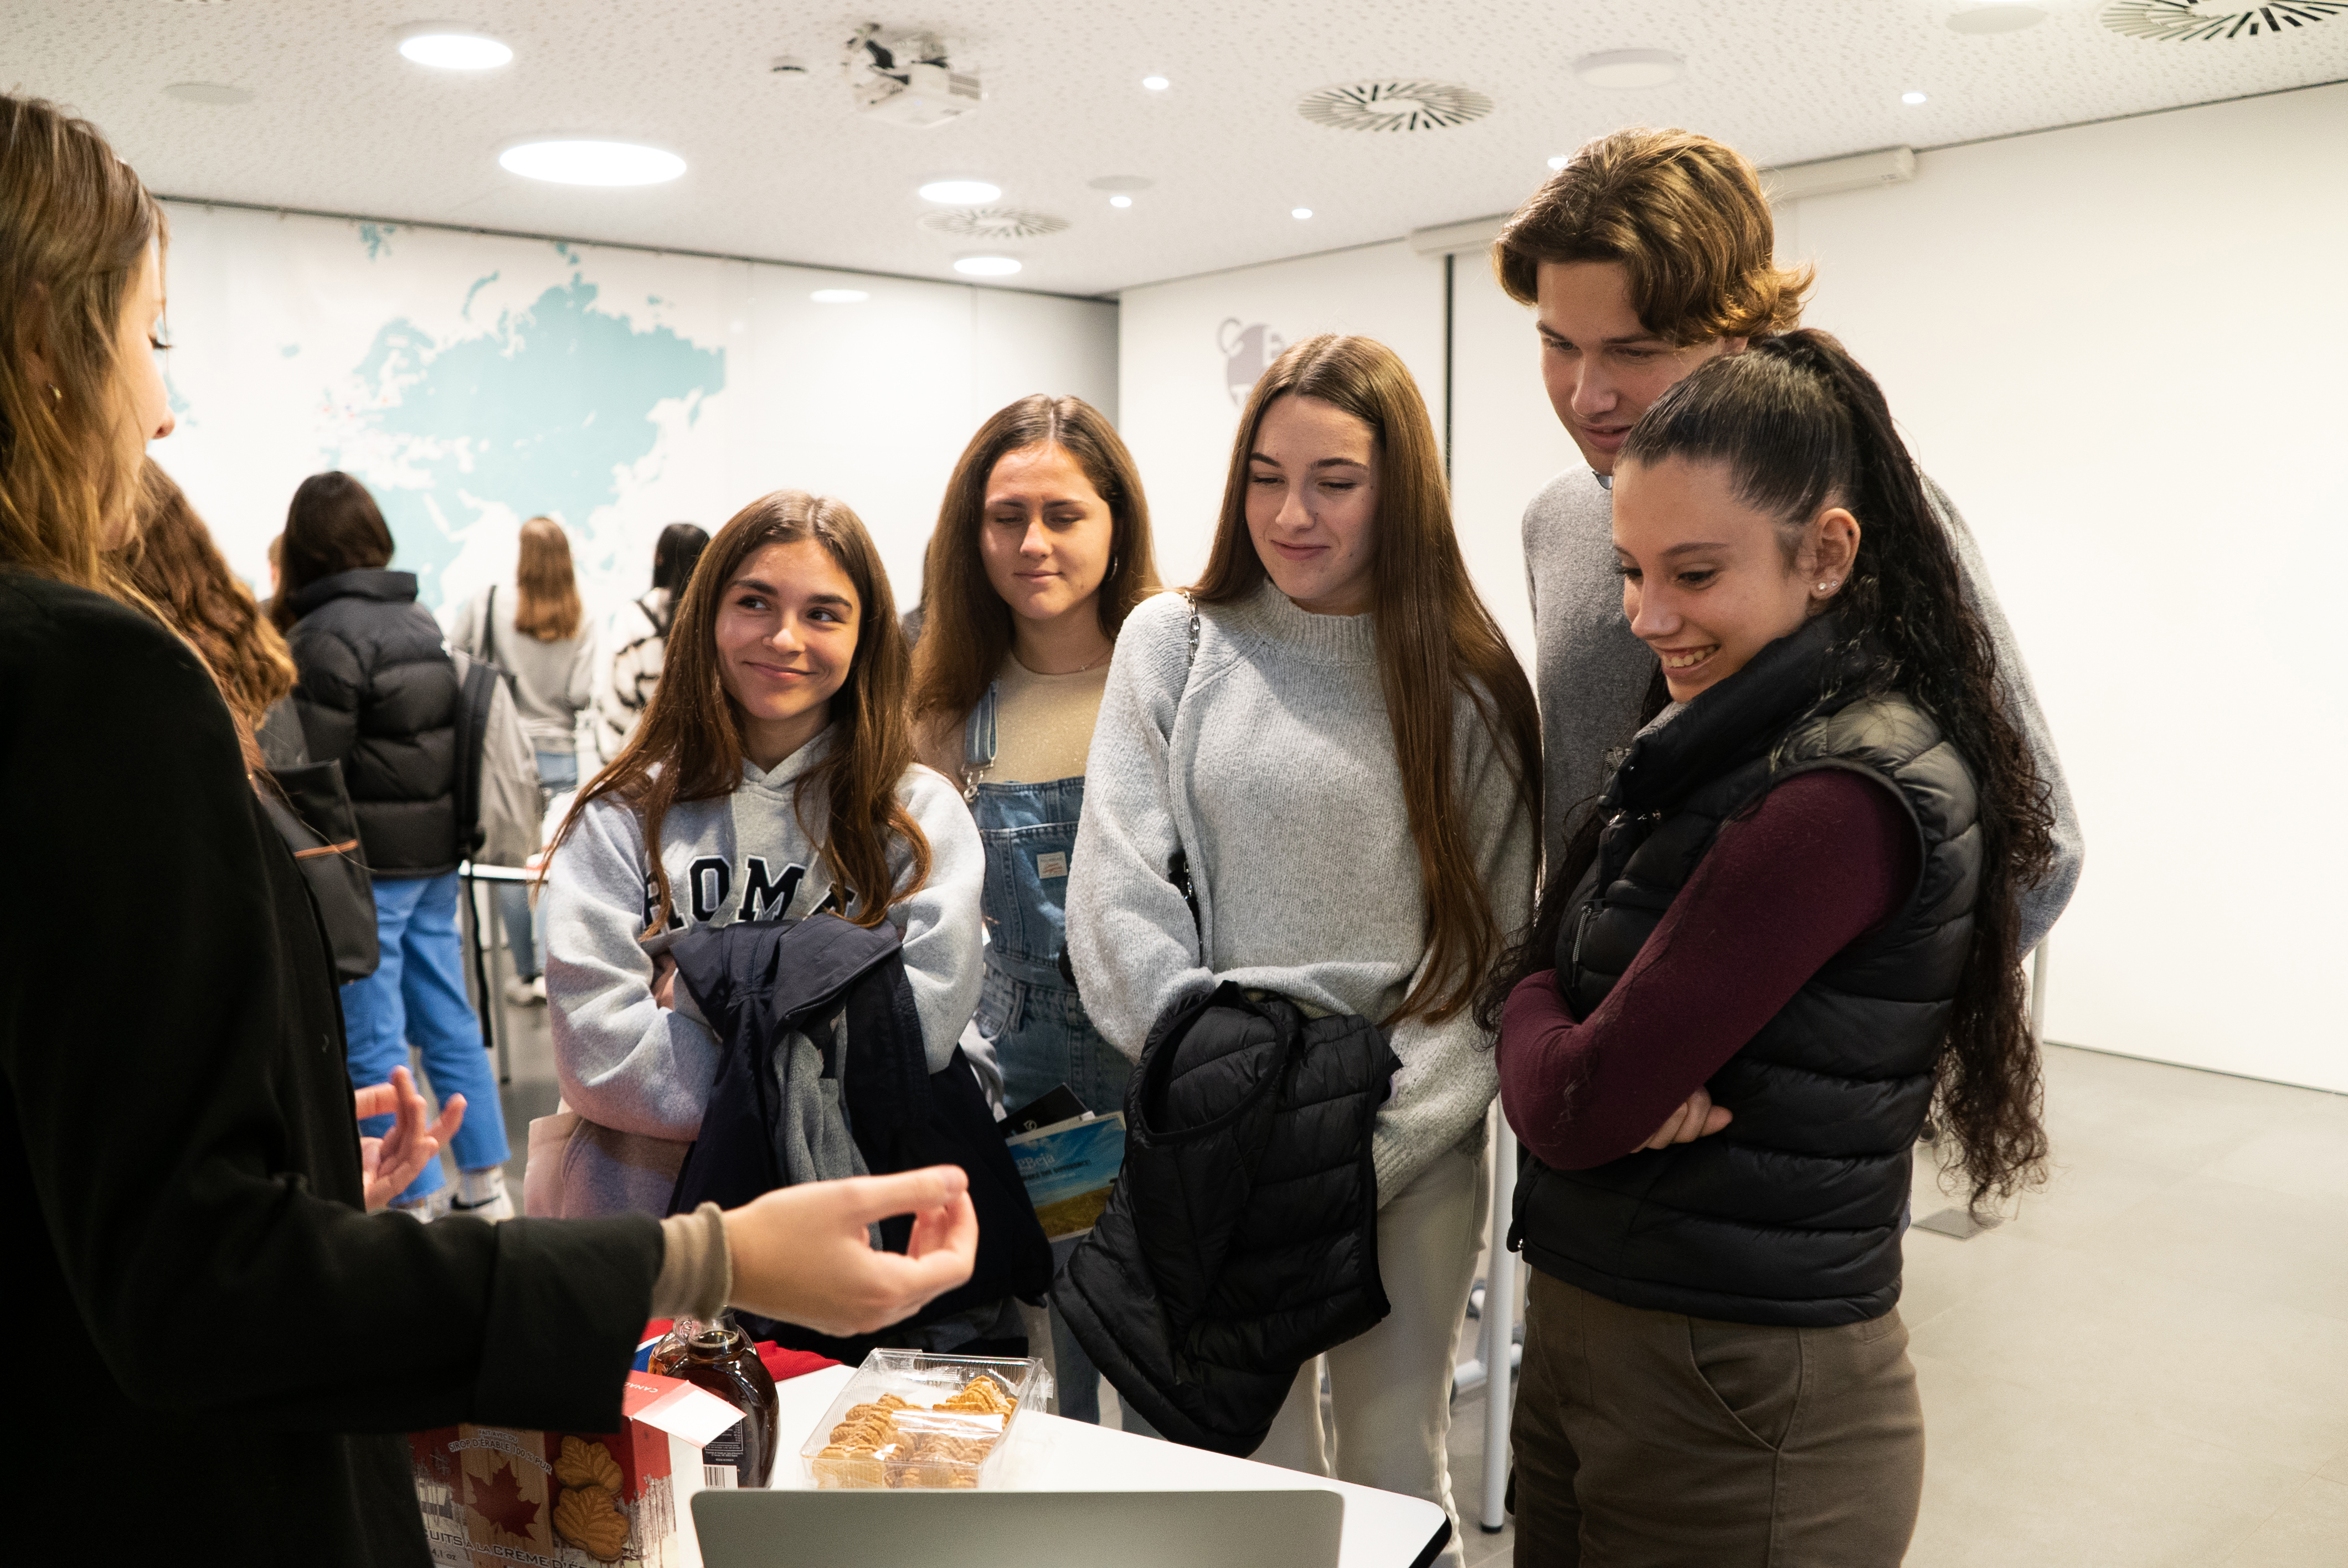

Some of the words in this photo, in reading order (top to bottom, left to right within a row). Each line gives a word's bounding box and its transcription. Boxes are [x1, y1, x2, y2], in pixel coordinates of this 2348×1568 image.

[449, 1440, 471, 1451] SIROP
[472, 1437, 510, 1451] D'ÉRABLE
[513, 1446, 525, 1457] 100
[527, 1453, 533, 1461] %
[535, 1457, 552, 1473] PUR
[430, 1530, 463, 1546] UITS
[477, 1544, 491, 1552] LA
[493, 1545, 549, 1567] CRÈME
